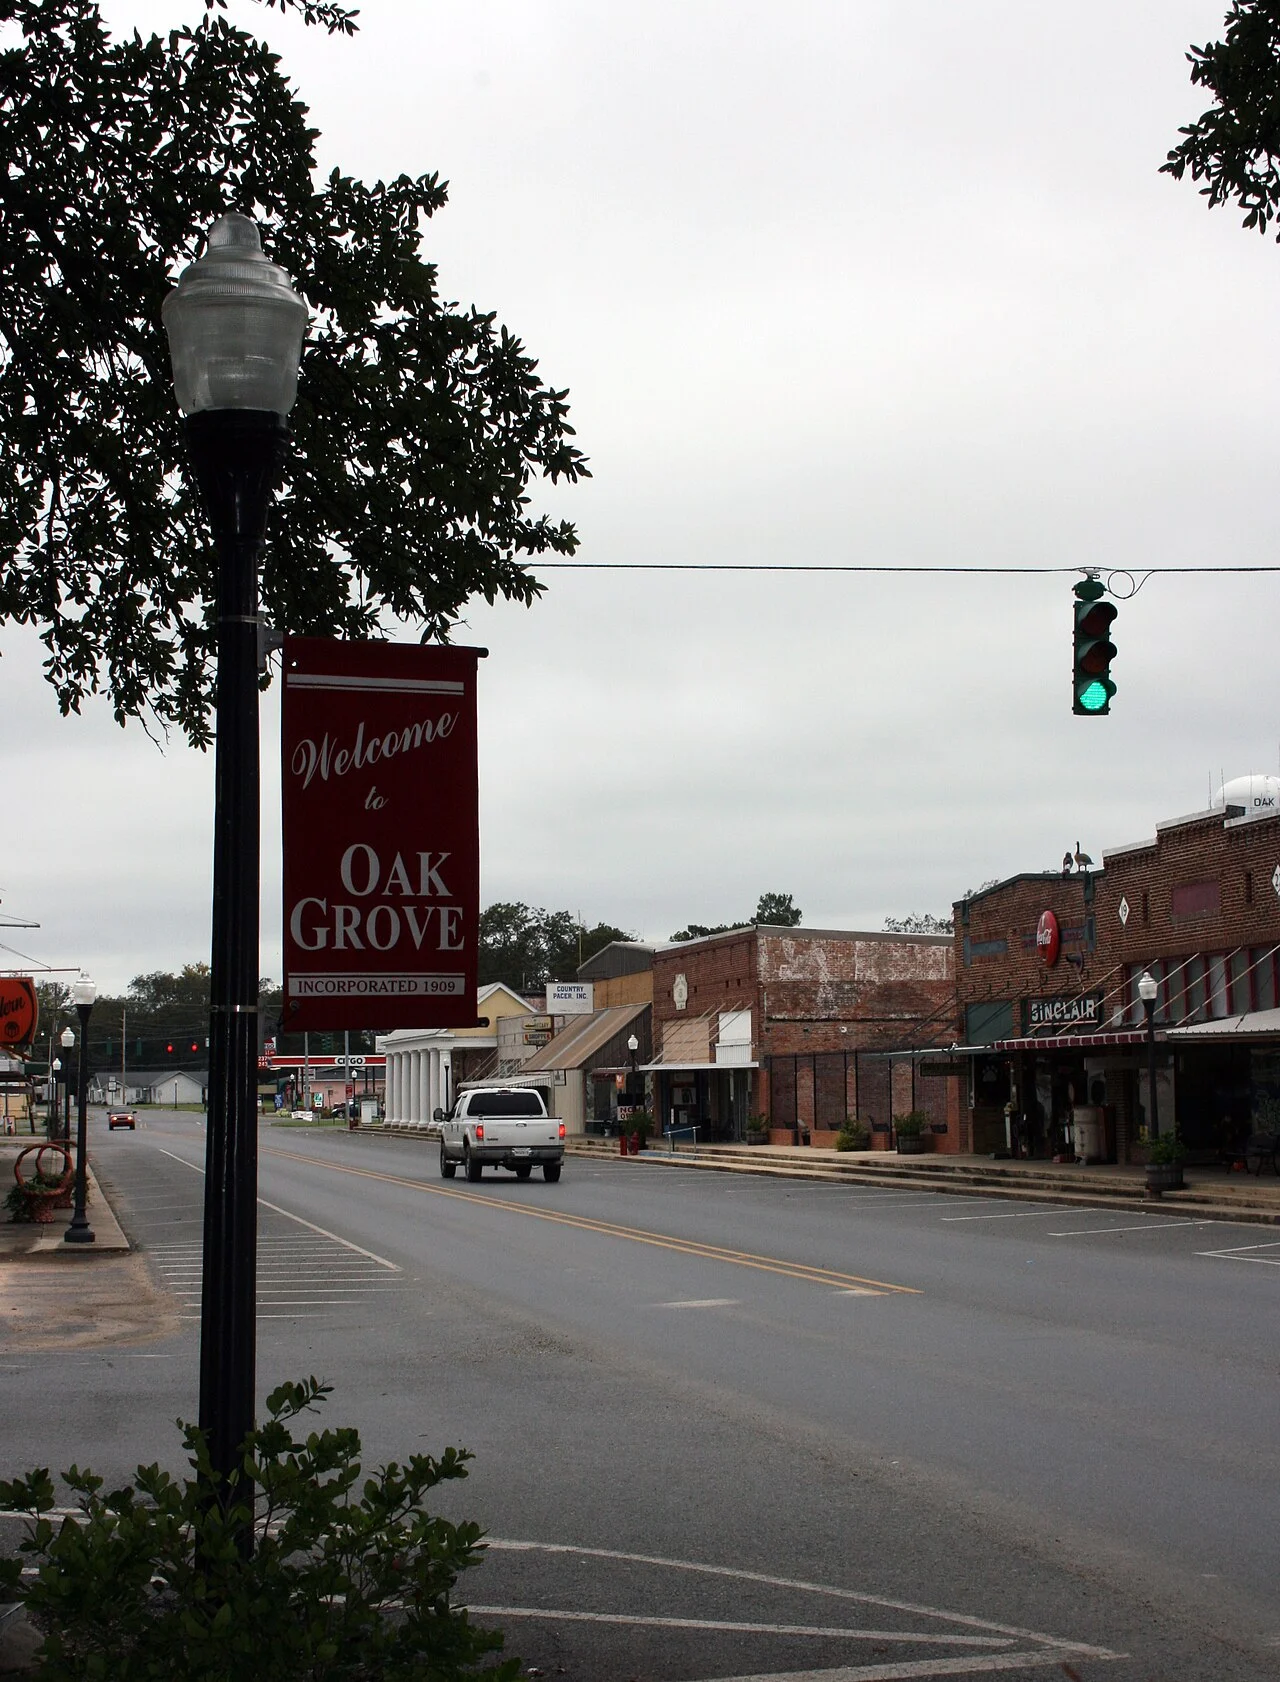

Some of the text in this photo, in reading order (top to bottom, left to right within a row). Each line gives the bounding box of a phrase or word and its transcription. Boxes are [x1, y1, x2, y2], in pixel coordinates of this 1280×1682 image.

[291, 711, 460, 791] Welcome
[364, 785, 390, 810] to
[1253, 797, 1275, 807] OAK
[339, 843, 453, 897] OAK
[290, 897, 465, 951] GROVE
[297, 979, 456, 994] INCORPORATED 1909
[556, 985, 584, 993] COUNTRY
[1031, 999, 1095, 1022] SINCLAIR
[337, 1056, 364, 1065] CIGO
